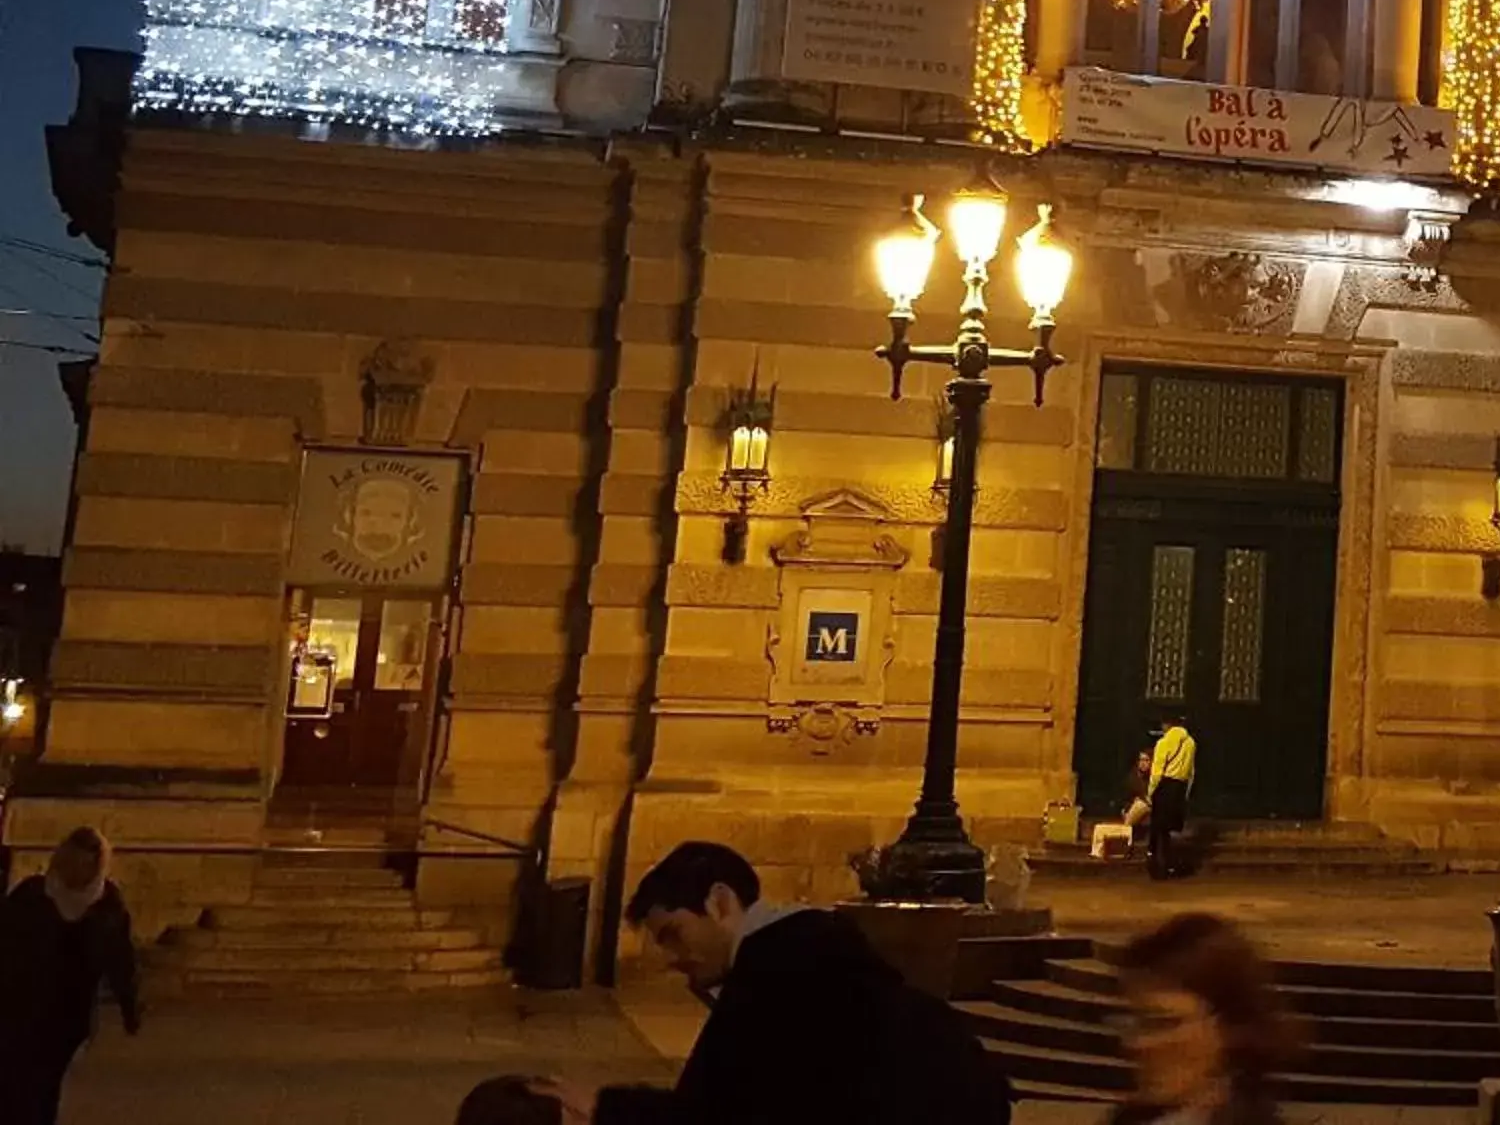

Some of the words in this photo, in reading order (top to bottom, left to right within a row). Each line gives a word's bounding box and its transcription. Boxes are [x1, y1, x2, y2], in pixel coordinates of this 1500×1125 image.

[1207, 88, 1258, 118] Bal
[1267, 91, 1287, 121] à
[1186, 114, 1291, 155] l'opéra
[815, 626, 849, 654] M
